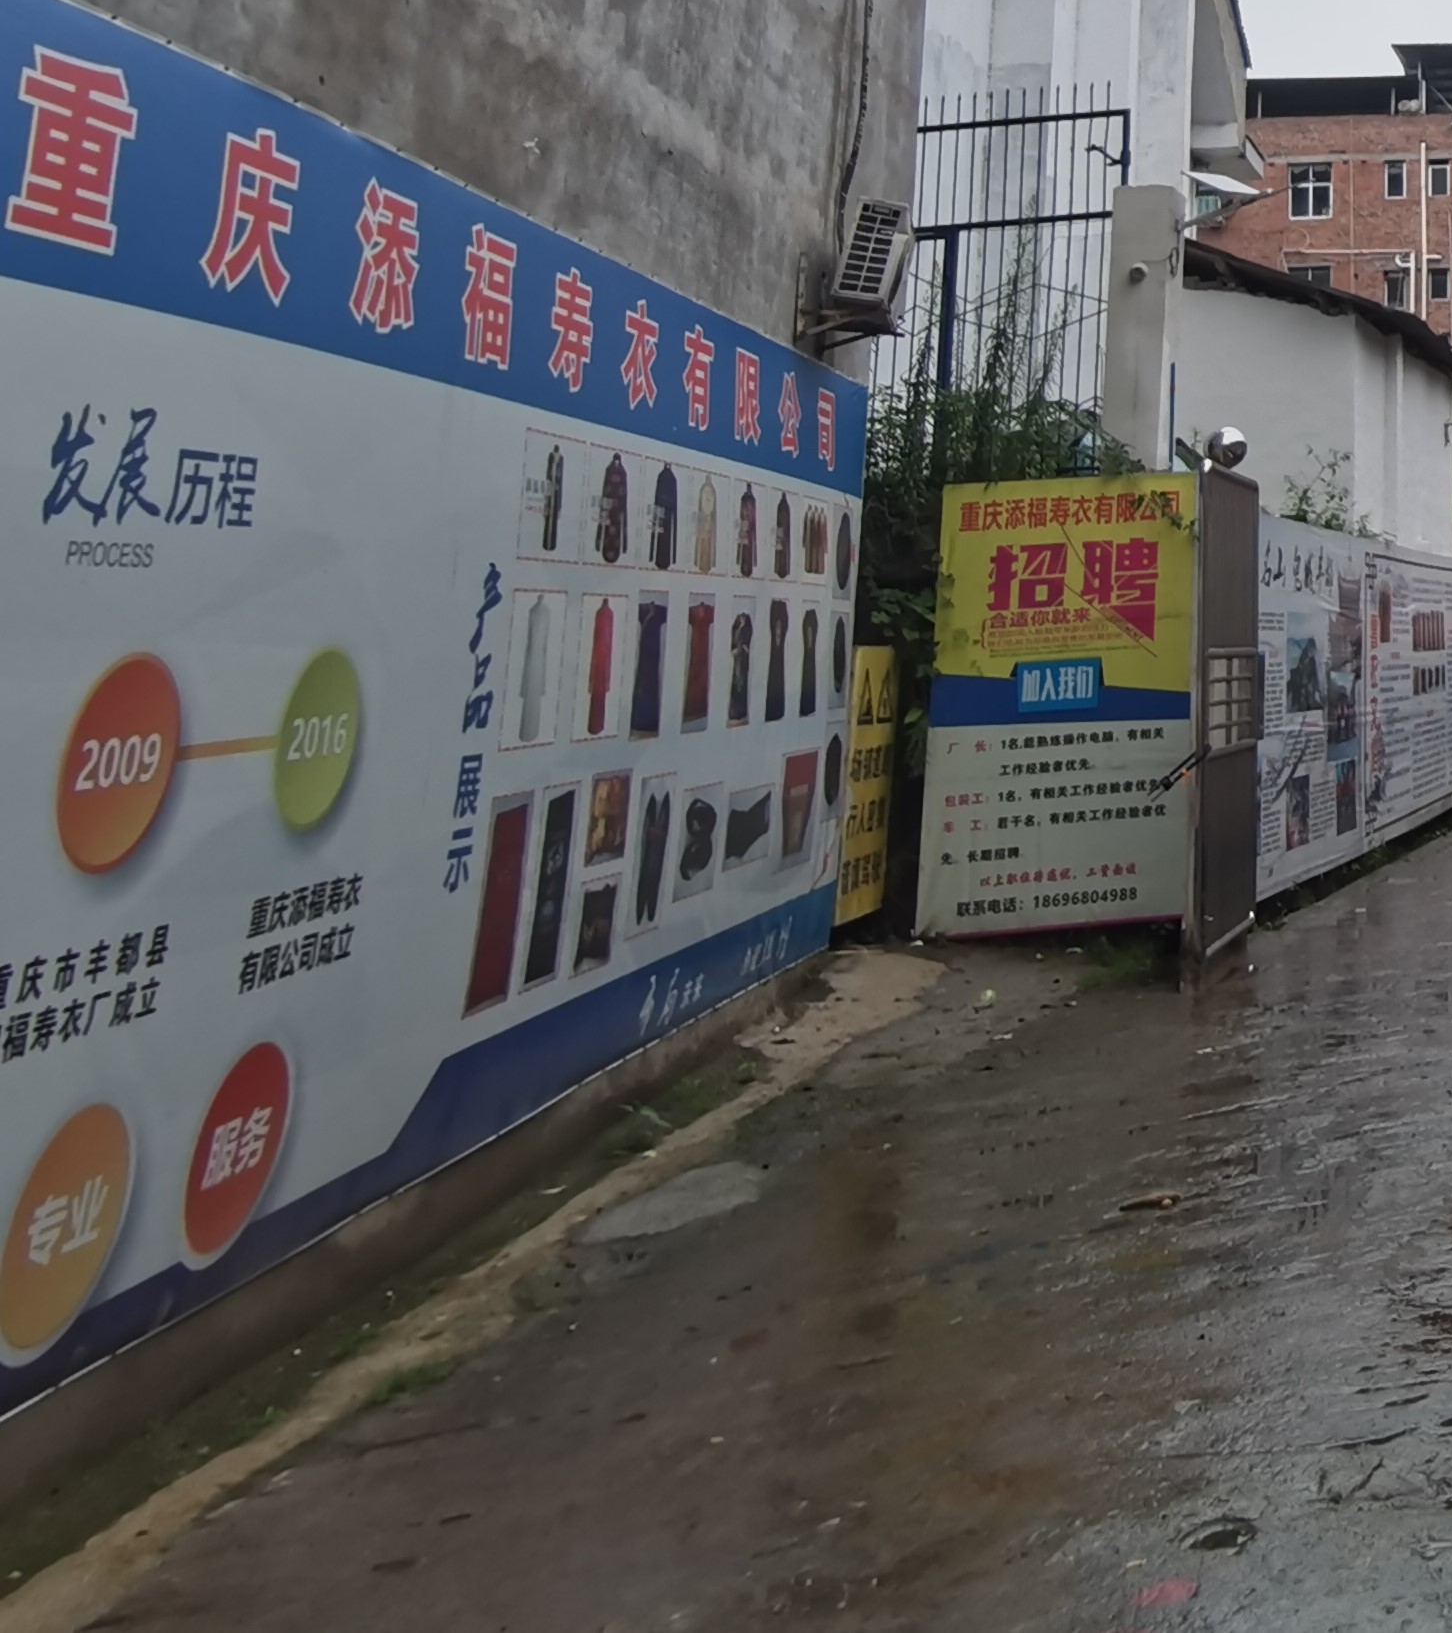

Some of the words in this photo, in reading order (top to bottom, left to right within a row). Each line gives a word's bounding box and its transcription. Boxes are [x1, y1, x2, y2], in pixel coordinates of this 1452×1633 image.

[5, 45, 838, 472] 重庆添福寿衣有限公司
[42, 404, 259, 530] 发展历程
[65, 540, 154, 569] PROCESS
[987, 537, 1160, 640] 招聘
[1021, 666, 1095, 703] 加入我们
[74, 732, 163, 793] 2009
[286, 711, 349, 762] 2016
[246, 873, 364, 940] 重庆添福寿衣
[238, 923, 356, 995] 有限公司成立
[0, 977, 161, 1064] 福寿衣厂成立
[202, 1105, 271, 1192] 服务
[27, 1176, 109, 1266] 专业
